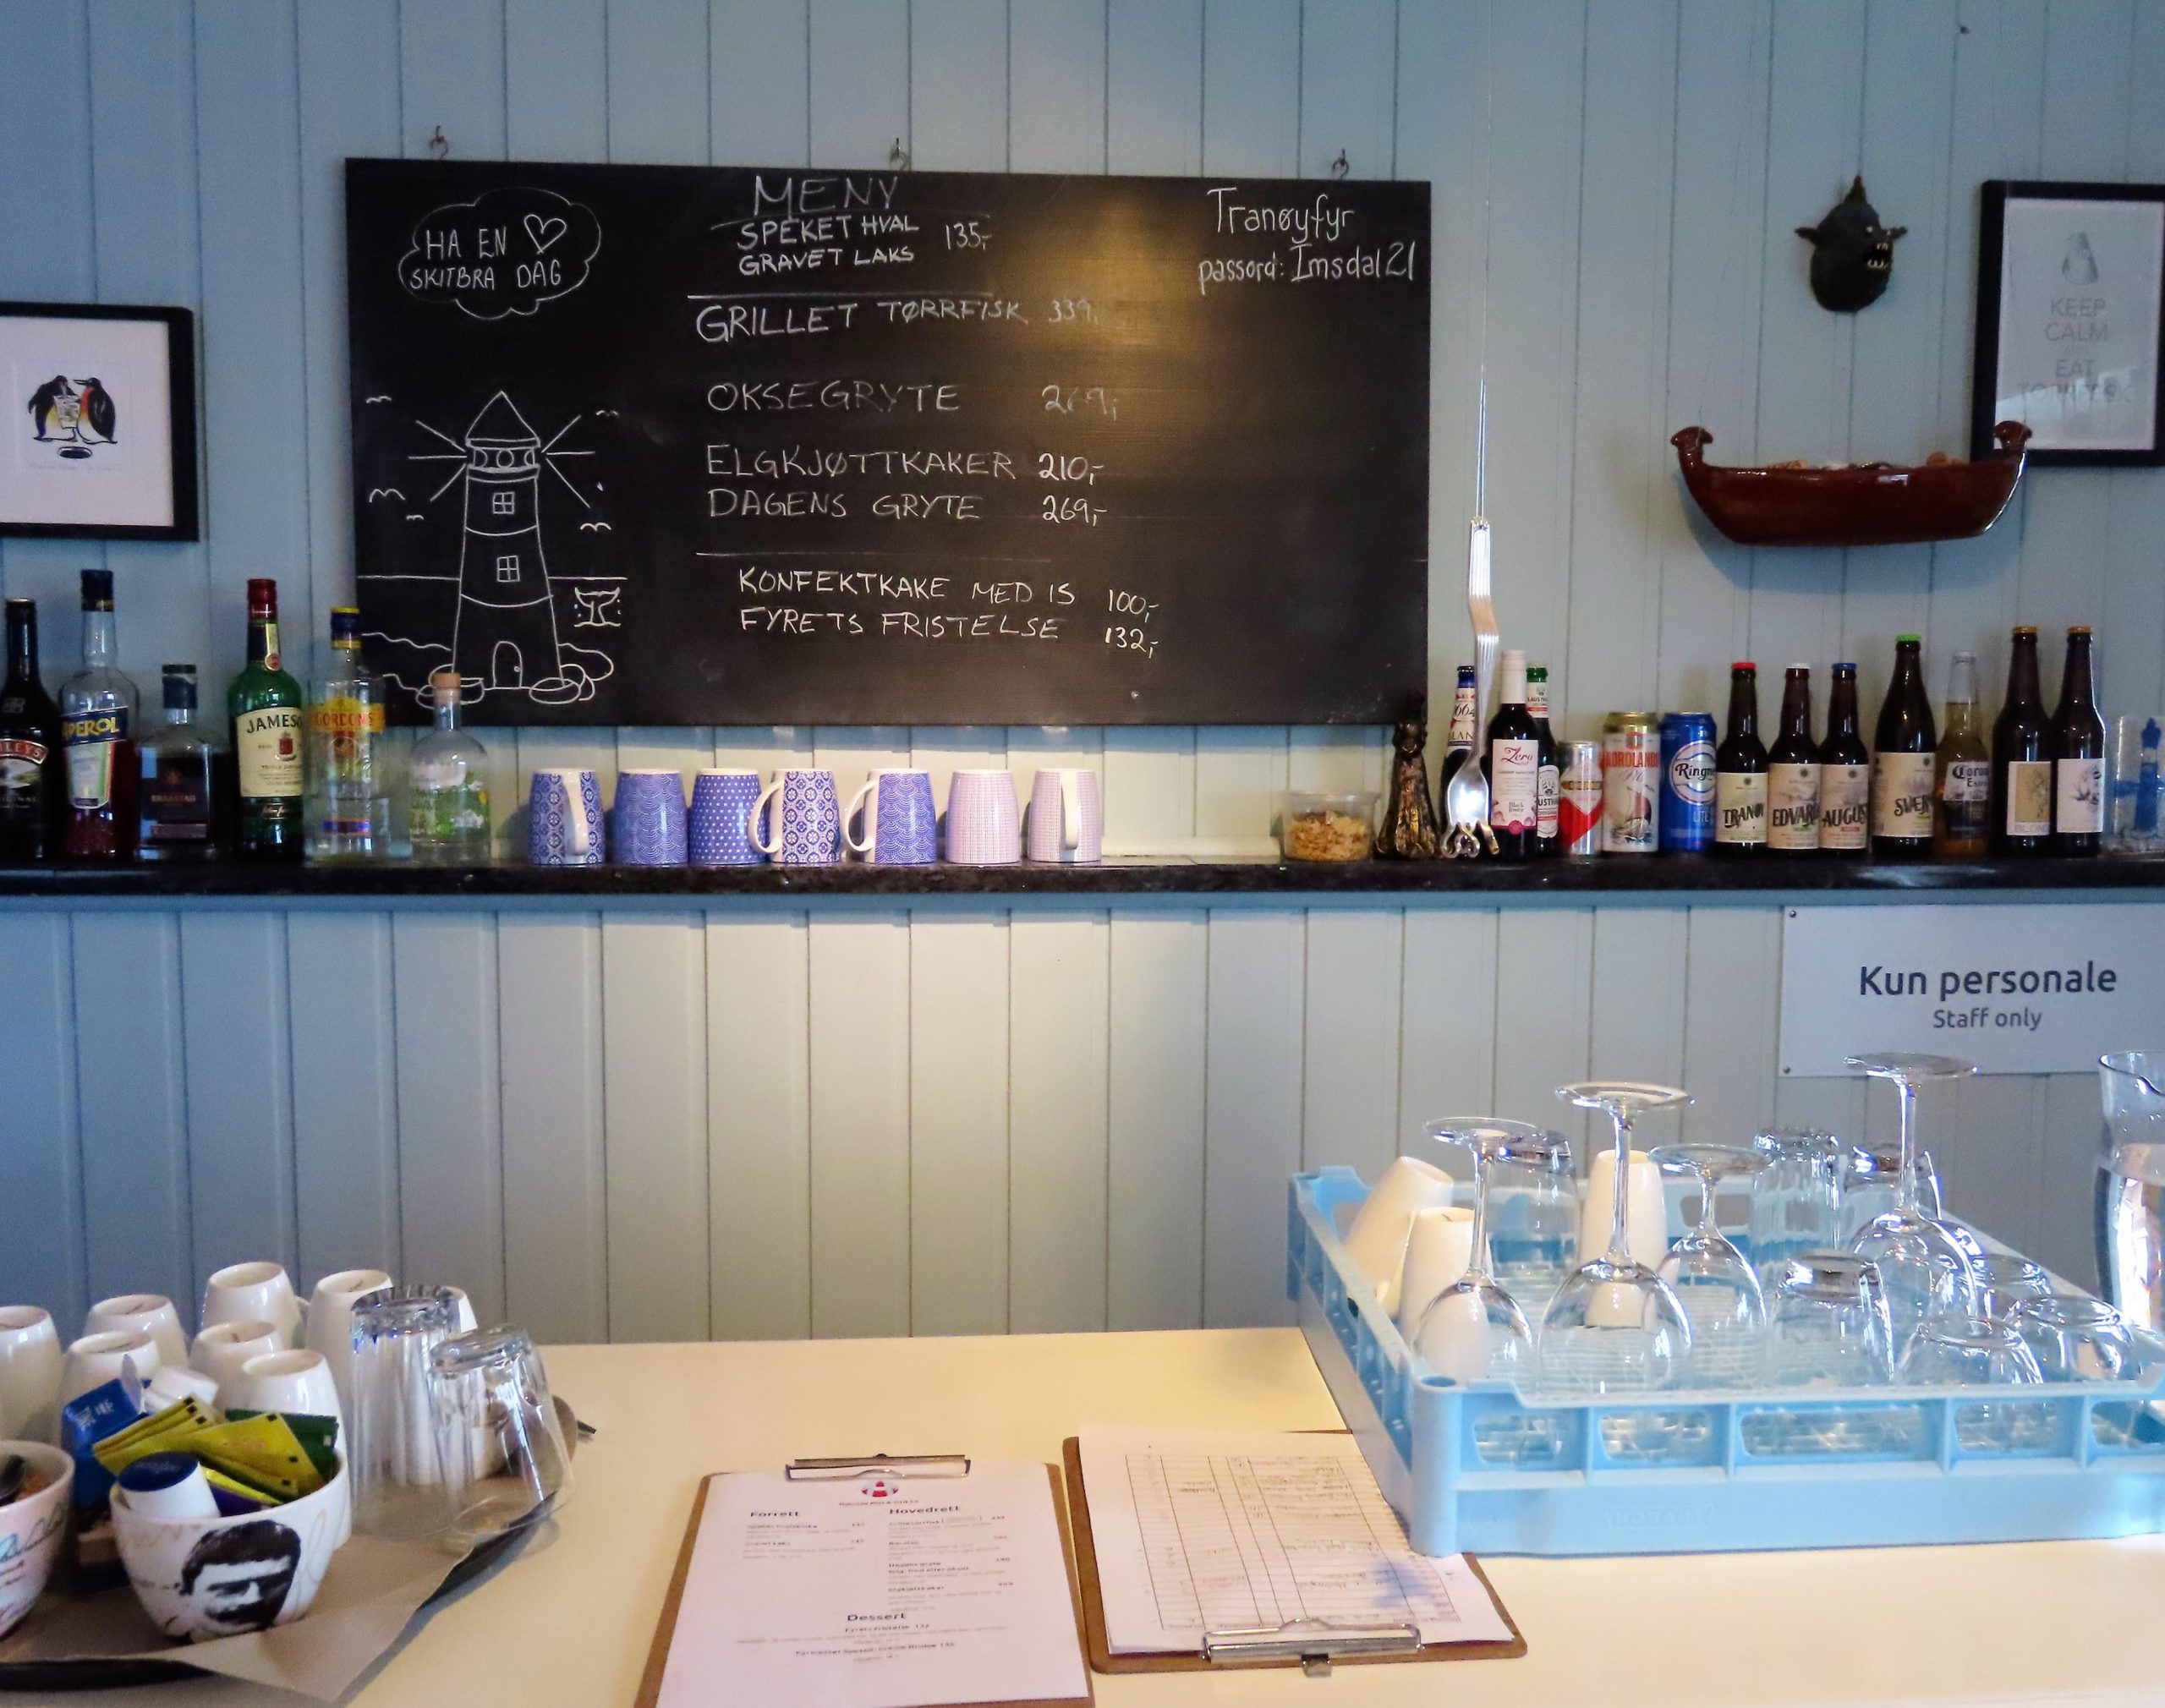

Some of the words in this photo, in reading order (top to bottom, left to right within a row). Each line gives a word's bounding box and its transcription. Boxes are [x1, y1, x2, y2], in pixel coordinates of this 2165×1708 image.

[754, 176, 898, 218] MENY
[1207, 187, 1355, 244] Tranøyfyr
[425, 230, 459, 260] HA
[479, 227, 507, 257] EN
[737, 216, 851, 249] SPEKET
[862, 215, 919, 235] HVAL
[410, 266, 496, 293] SKITBRA
[517, 261, 562, 289] DAG
[739, 248, 843, 276] GRAVET
[854, 248, 914, 266] LAKS
[1198, 251, 1284, 296] passord:
[695, 303, 858, 343] GRILLET
[2050, 298, 2107, 317] KEEP
[2044, 322, 2108, 342] CALM
[2055, 359, 2095, 378] EAT
[707, 444, 1017, 480] ELGKJØTTKAKER
[708, 488, 847, 519] DAGENS
[872, 493, 983, 520] GRYTE
[739, 567, 951, 601] KONFEKTKAKE
[972, 580, 1033, 605] MED
[1050, 582, 1076, 607] IS
[740, 606, 863, 635] FYRETS
[881, 613, 1059, 640] FRISTELSE
[1454, 703, 1475, 718] 664
[1501, 746, 1533, 765] Zero
[1822, 804, 1866, 828] AUGUS
[1861, 966, 1927, 996] Kun
[1940, 961, 2117, 1001] personale
[1932, 1008, 1988, 1028] Staff
[1996, 1008, 2042, 1031] only
[889, 1505, 961, 1514] Hovedrett
[847, 1612, 907, 1623] Dessert
